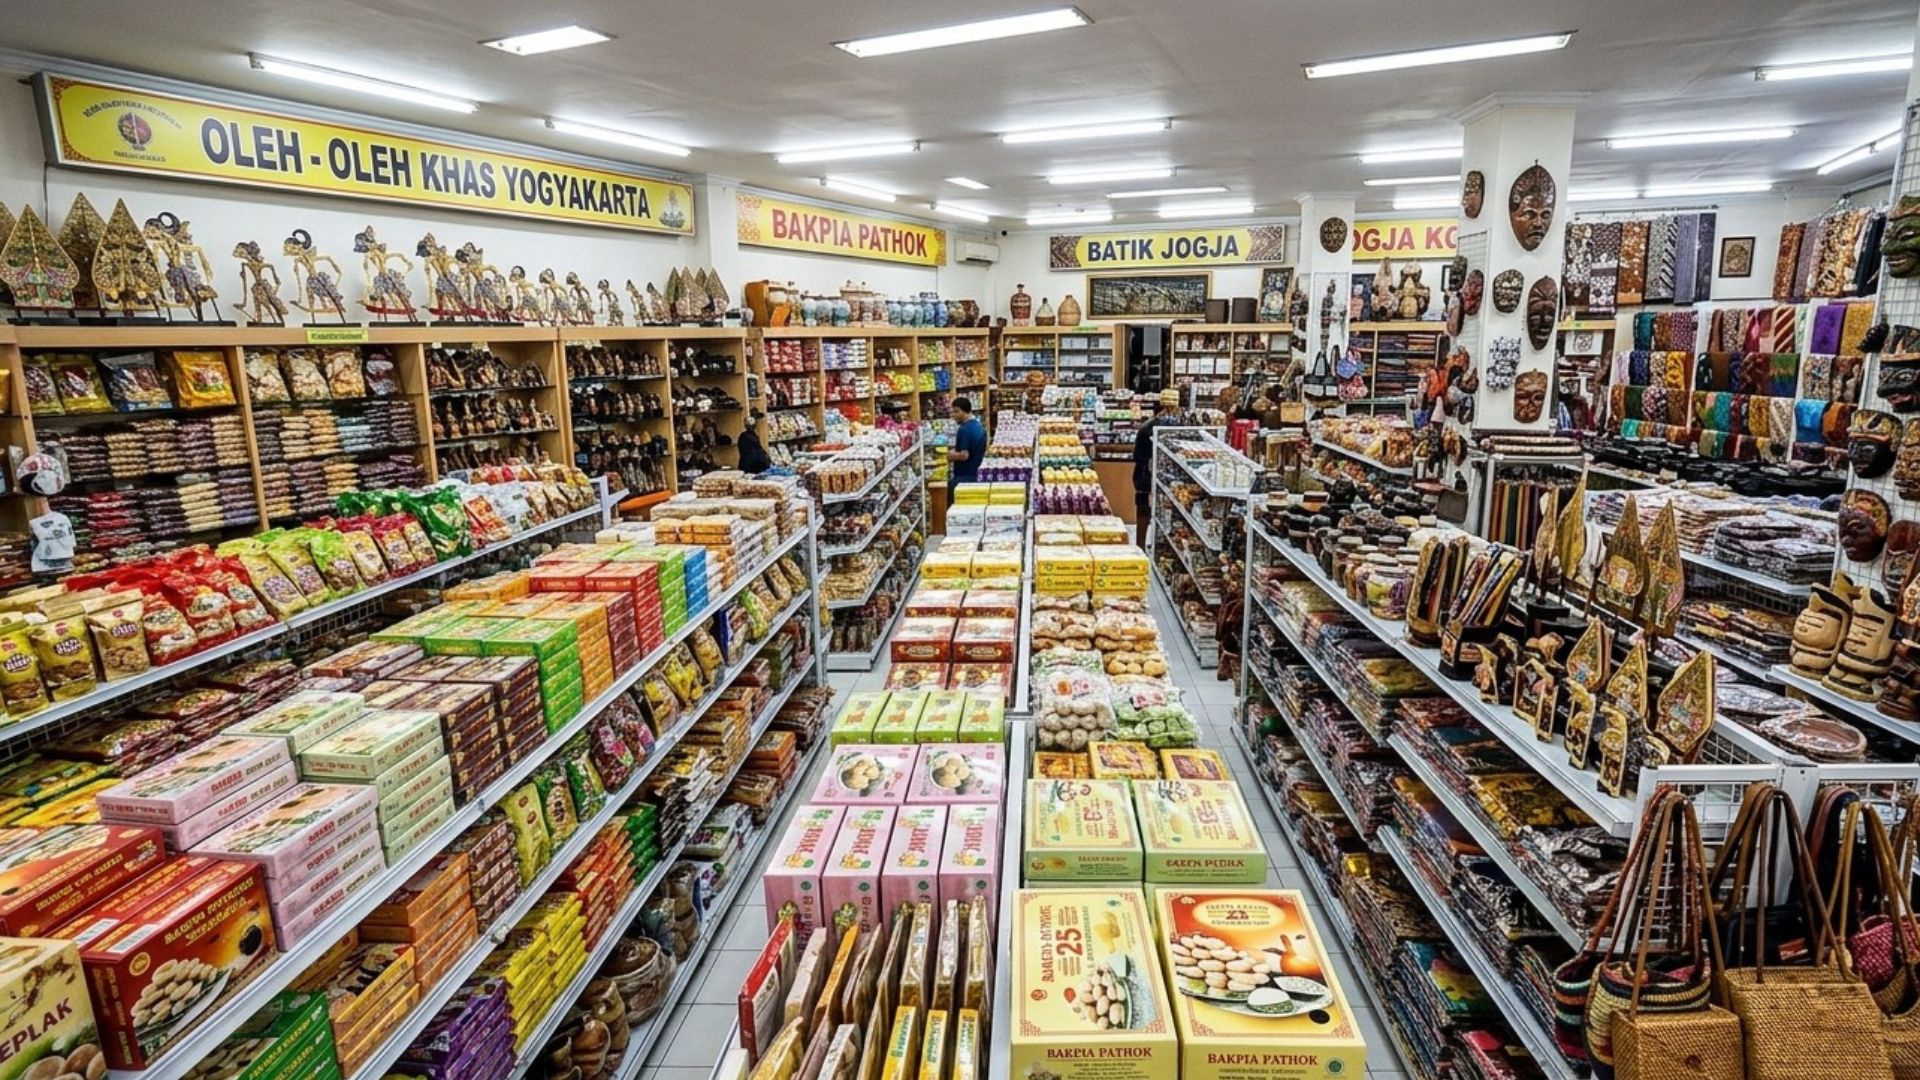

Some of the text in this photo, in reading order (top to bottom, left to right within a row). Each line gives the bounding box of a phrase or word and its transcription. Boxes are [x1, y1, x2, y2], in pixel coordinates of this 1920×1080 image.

[201, 117, 303, 174] OLEH
[328, 137, 412, 188] OLEH
[420, 152, 496, 198] KHAS
[502, 165, 651, 219] YOGYAKARTA
[772, 208, 928, 258] BAKPIA PATHOK
[1087, 235, 1239, 262] BATIK JOGJA
[1055, 927, 1083, 956] 25
